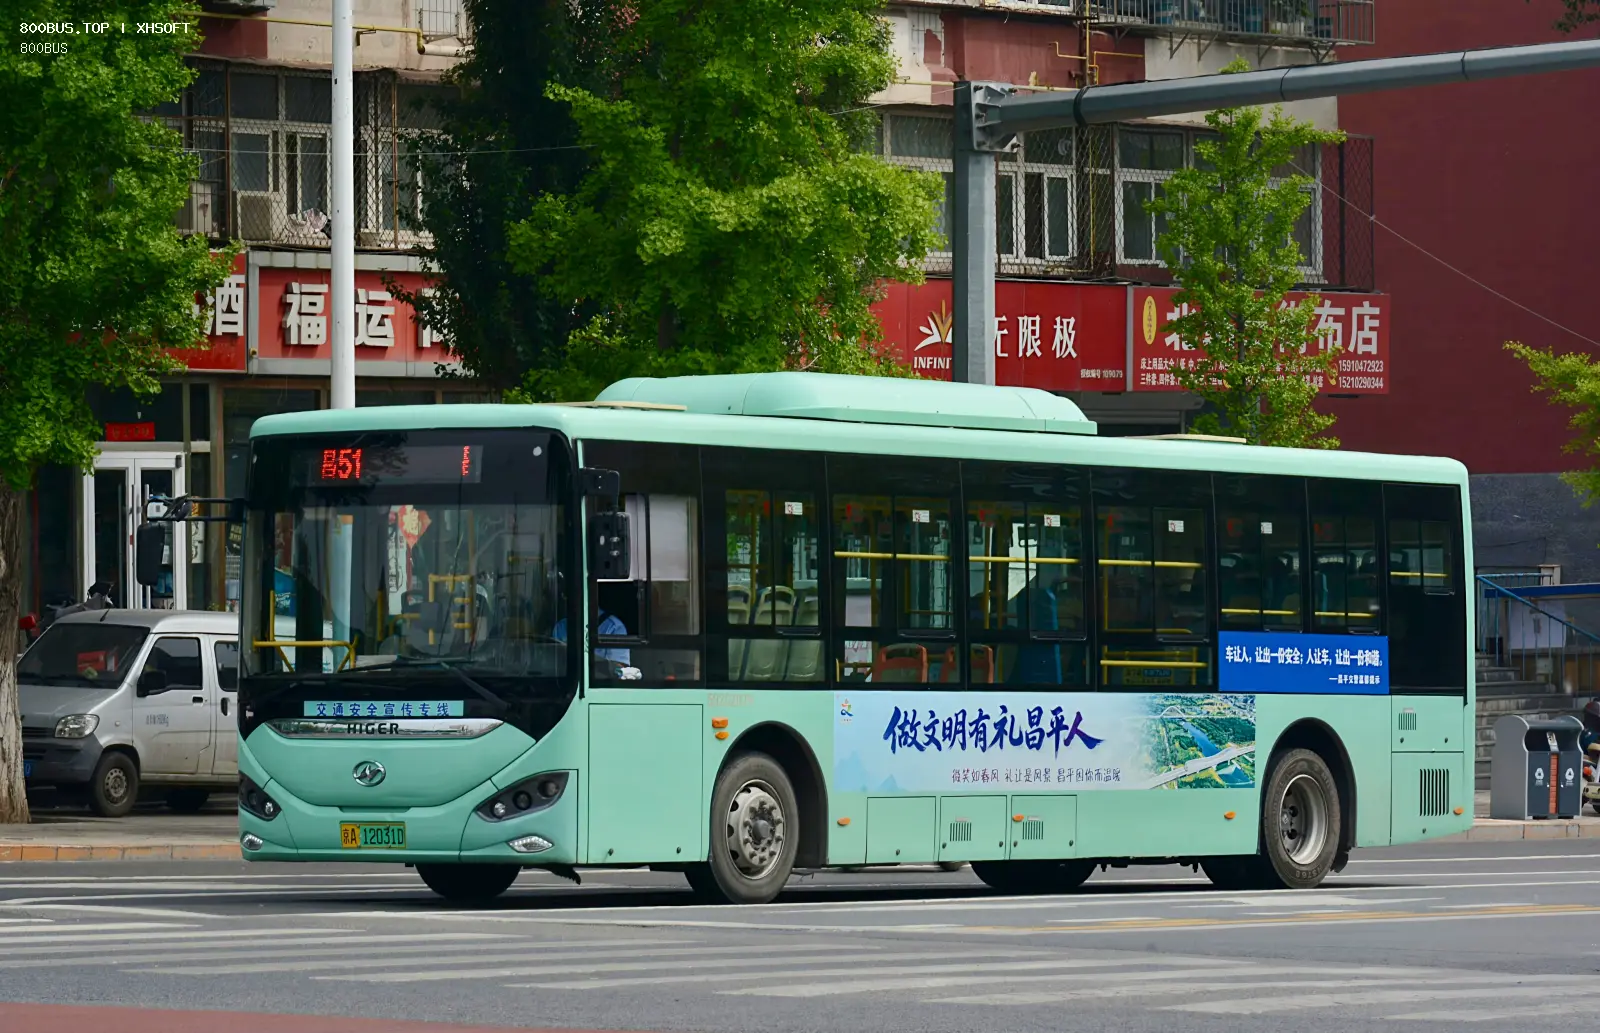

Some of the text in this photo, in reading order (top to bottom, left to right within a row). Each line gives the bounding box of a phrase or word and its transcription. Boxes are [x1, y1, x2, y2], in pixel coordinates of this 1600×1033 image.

[994, 314, 1078, 359] 无限极
[316, 702, 450, 717] 交通安全宣传专线
[347, 722, 400, 735] HIGER
[882, 704, 1105, 760] 做文明有礼昌平人
